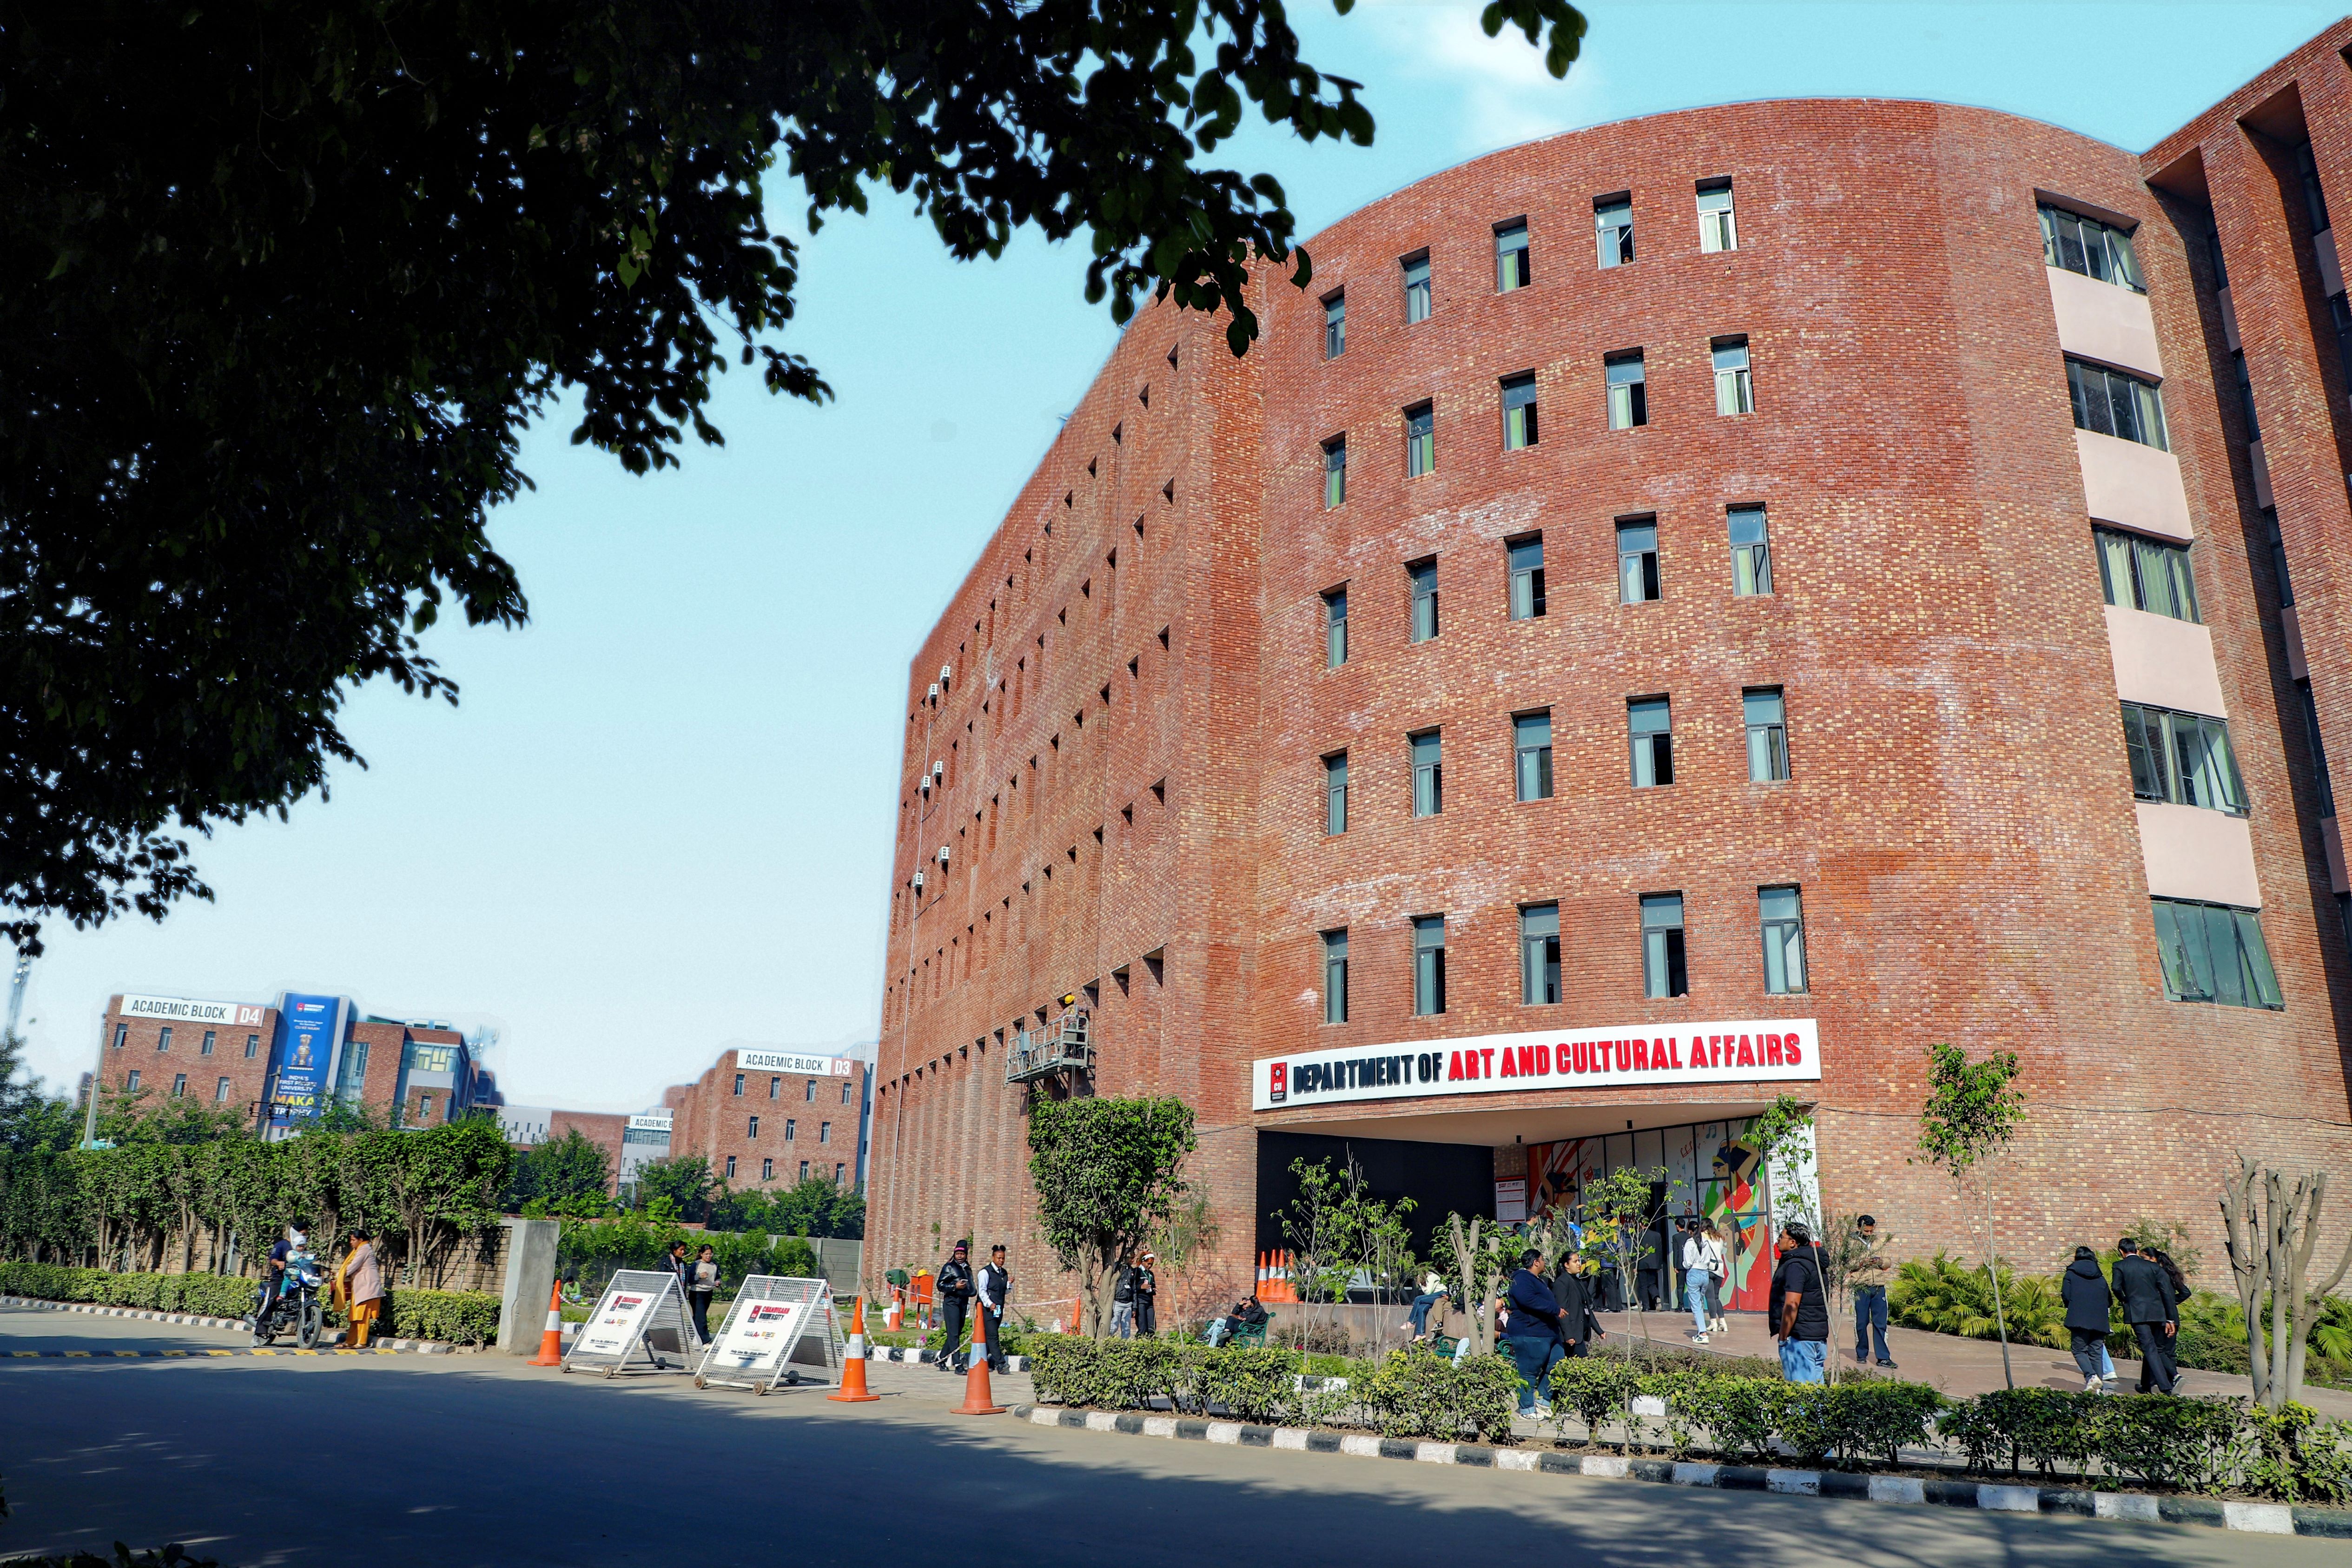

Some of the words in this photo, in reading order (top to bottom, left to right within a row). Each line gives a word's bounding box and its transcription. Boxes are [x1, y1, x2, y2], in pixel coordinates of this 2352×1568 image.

[131, 999, 189, 1016] ACADEMIC
[191, 1005, 227, 1019] BLOCK
[239, 1007, 260, 1024] D4
[746, 1054, 793, 1068] ACADEMIC
[795, 1058, 824, 1071] BLOCK
[834, 1059, 851, 1075] D3
[1294, 1053, 1414, 1093] DEPARTMENT
[1418, 1052, 1443, 1082] OF
[1448, 1048, 1494, 1080] ART
[1500, 1045, 1550, 1077] AND
[1556, 1038, 1683, 1073] CULTURAL
[1690, 1033, 1802, 1067] AFFAIRS
[1274, 1082, 1282, 1091] CU
[276, 1094, 315, 1106] MAKA
[635, 1118, 667, 1128] ACADEMIC
[762, 1306, 791, 1314] CHANDIGARH
